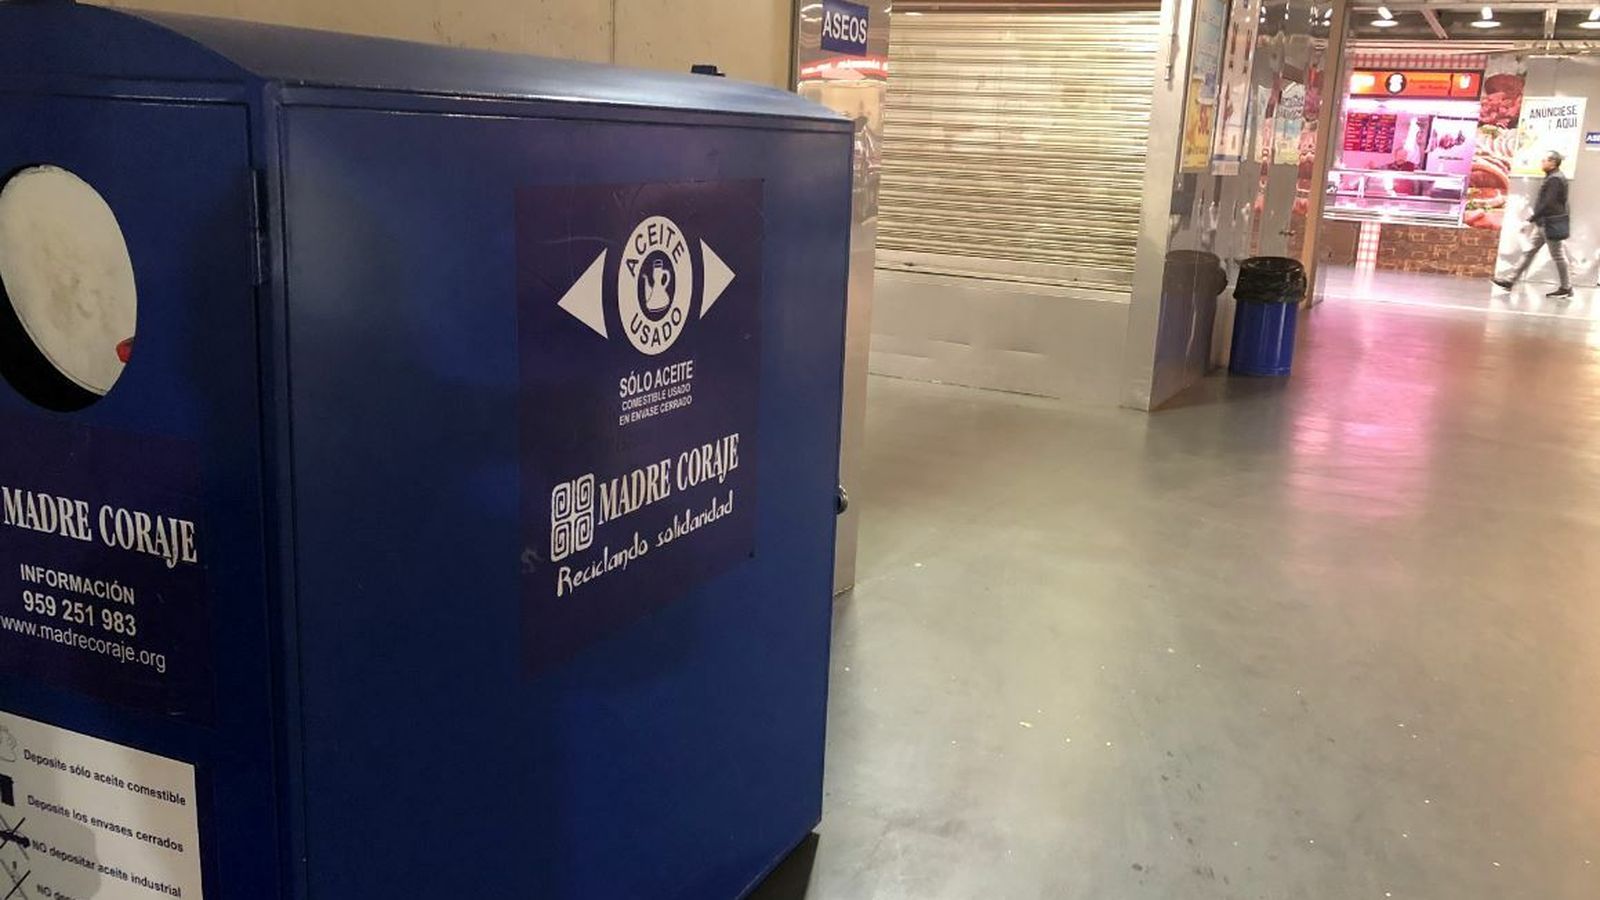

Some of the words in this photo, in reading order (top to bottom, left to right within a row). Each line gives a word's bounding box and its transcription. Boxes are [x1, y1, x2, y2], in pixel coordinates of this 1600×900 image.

[822, 11, 868, 44] ASEOS
[626, 223, 685, 277] ACEITE
[630, 307, 682, 347] USADO
[619, 370, 653, 398] SÓLO
[654, 360, 693, 388] ACEITE
[622, 389, 666, 411] COMESTIBLE
[667, 383, 691, 398] USADO
[619, 414, 630, 426] EN
[631, 404, 660, 422] ENVASE
[660, 395, 693, 413] CERRADO
[598, 459, 672, 525] MADRE
[676, 433, 740, 491] CORAJE
[1, 486, 93, 541] MADRE
[99, 505, 198, 569] CORAJE
[557, 532, 649, 597] Reciclando
[655, 489, 734, 547] solidaridad
[20, 563, 135, 605] INFORMACIÓN
[23, 590, 57, 616] 959
[62, 599, 94, 626] 251
[101, 608, 136, 636] 983
[0, 615, 166, 673] www.madrecoraje.org
[24, 748, 67, 771] Deposite
[69, 764, 91, 779] sólo
[94, 772, 125, 788] aceite
[127, 781, 186, 806] comestible
[27, 795, 70, 818] Deposite
[73, 809, 88, 823] los
[91, 817, 133, 837] envases
[136, 831, 184, 853] cerrados
[32, 839, 47, 853] NO
[49, 846, 95, 869] depositar
[98, 864, 128, 881] aceite
[131, 872, 182, 898] industrial
[36, 883, 51, 898] NO
